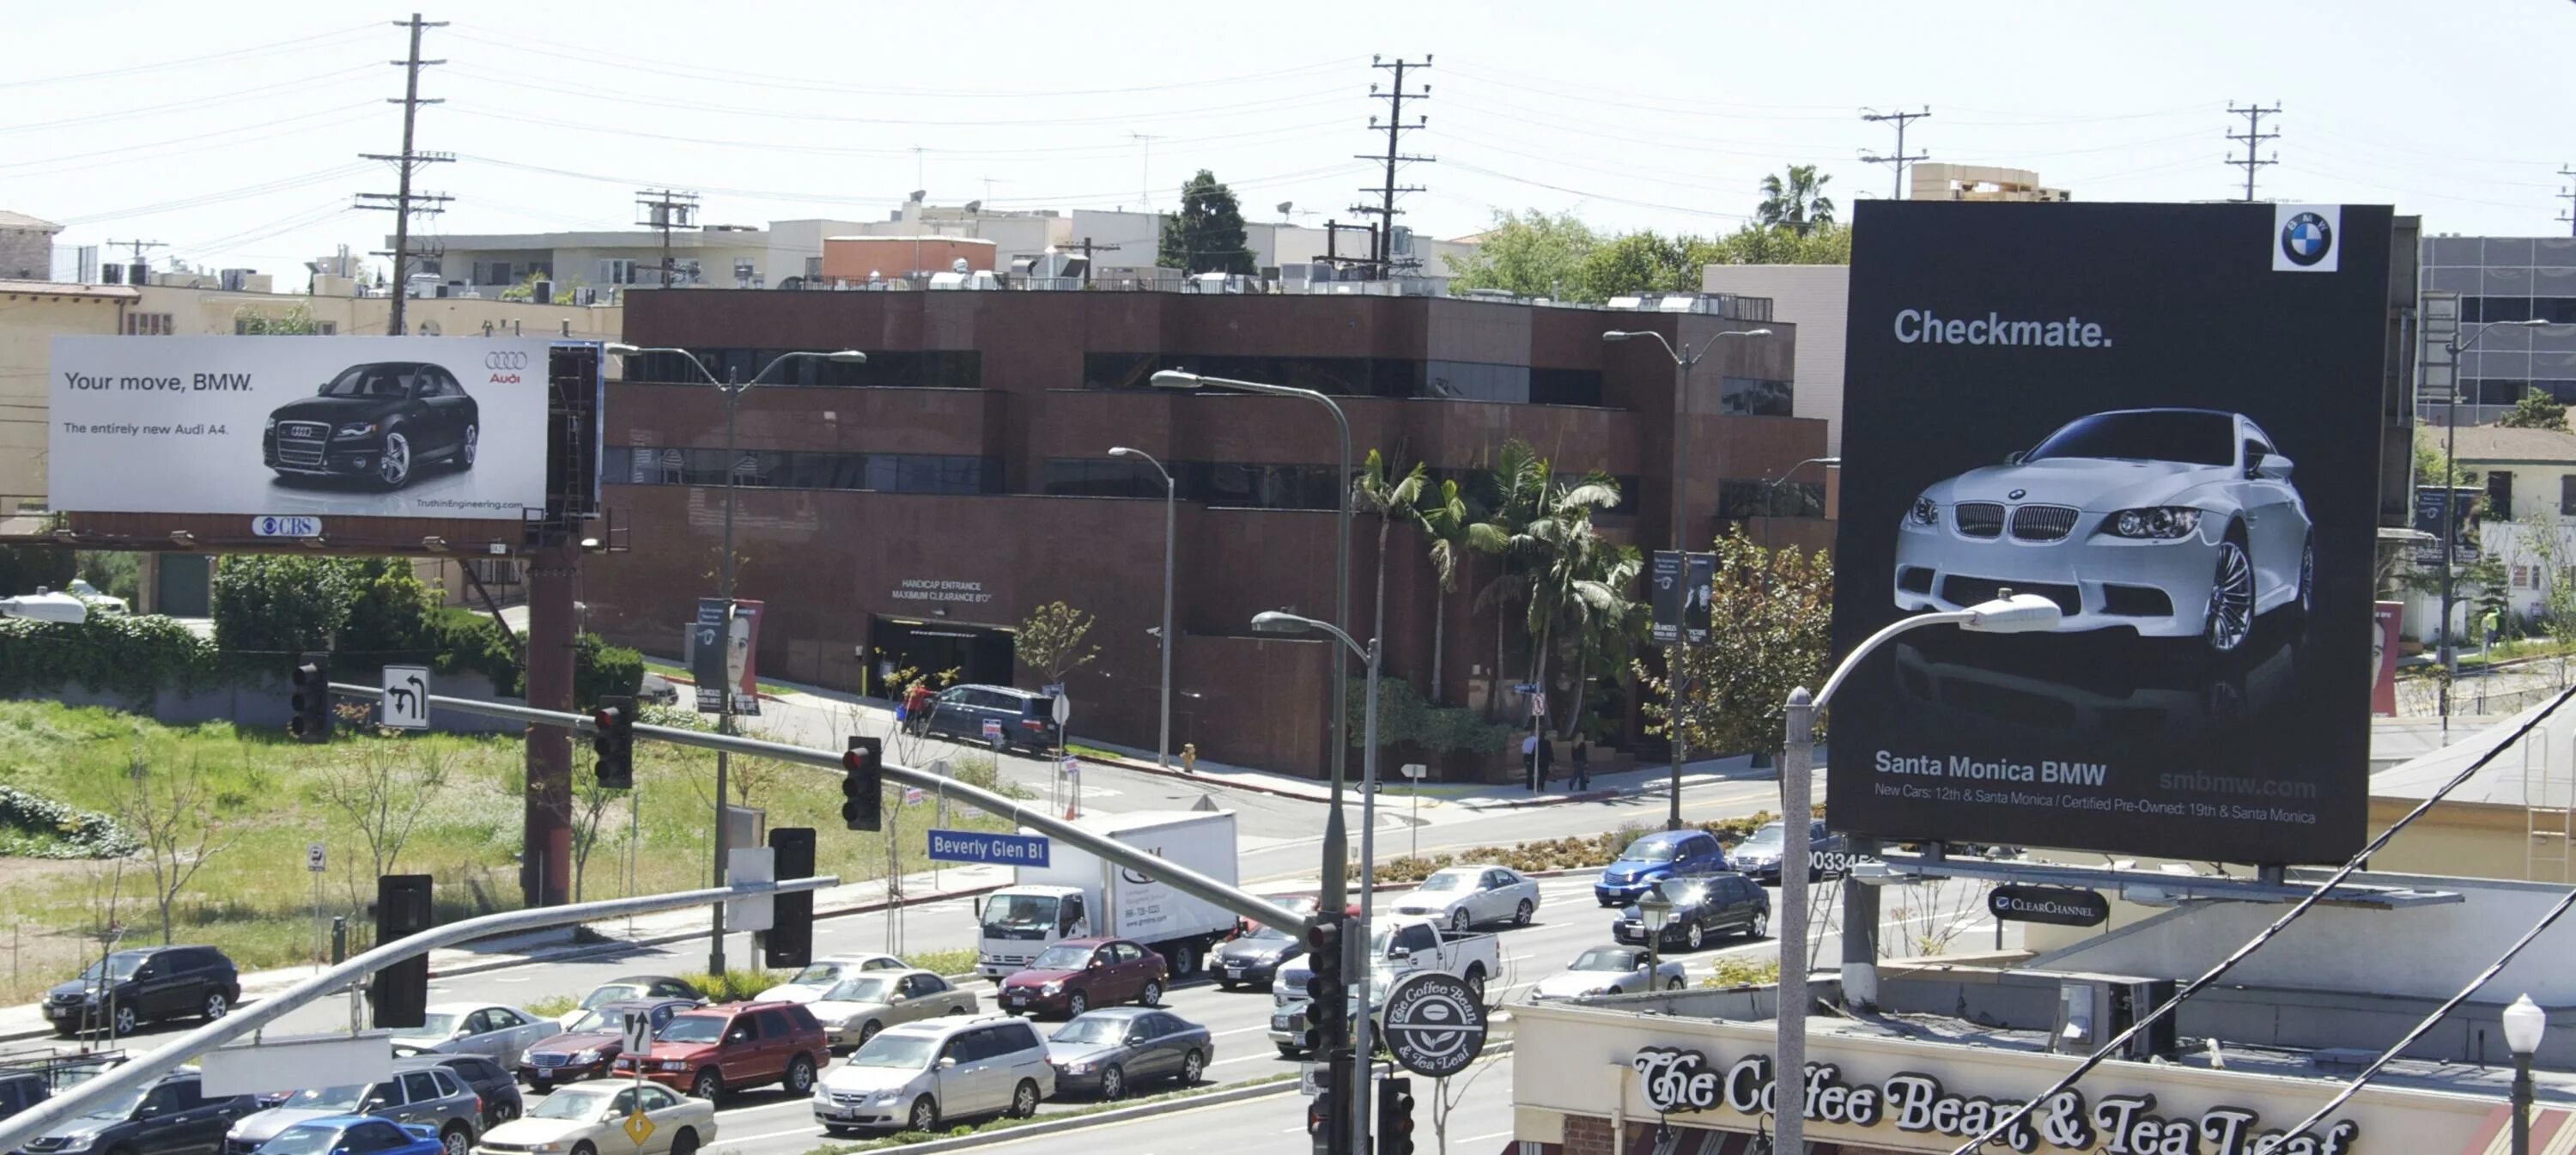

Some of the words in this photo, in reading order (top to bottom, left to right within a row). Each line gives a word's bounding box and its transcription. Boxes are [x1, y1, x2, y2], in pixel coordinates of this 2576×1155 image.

[2287, 214, 2329, 232] BMW
[1894, 308, 2112, 348] Checkmate.
[64, 372, 113, 391] Your
[120, 375, 186, 393] move,
[193, 373, 253, 392] BMW.
[489, 373, 520, 384] Audi
[64, 422, 87, 434] The
[91, 423, 139, 436] entirely
[143, 426, 171, 435] new
[175, 423, 204, 435] Audi
[208, 425, 228, 435] A4.
[279, 518, 312, 535] CBS
[892, 590, 928, 600] MAXIMUM
[929, 592, 975, 602] CLEARANCE
[902, 579, 939, 589] HANDICAP
[941, 581, 981, 591] ENTRANCE
[1875, 750, 1942, 776] Santa
[1948, 755, 2035, 782] Monica
[2041, 761, 2107, 787] BMW
[2159, 770, 2317, 799] smbmw.com
[1874, 782, 1900, 796] New
[1903, 783, 1931, 799] Cars:
[1935, 787, 1961, 801] 12th
[1963, 788, 1973, 802] &
[1975, 789, 2008, 804] Santa
[2011, 791, 2053, 806] Monica
[2062, 793, 2111, 811] Certified
[2113, 799, 2185, 815] Pre-Owned:
[2190, 802, 2216, 817] 19th
[2219, 805, 2229, 818] &
[2232, 805, 2268, 821] Santa
[2269, 808, 2316, 824] Monica
[934, 836, 987, 860] Beverly
[992, 840, 1024, 858] Glen
[1028, 843, 1043, 859] Bl
[1389, 1000, 1409, 1023] The
[1405, 981, 1449, 1002] Coffee
[1449, 985, 1477, 1024] Bean
[1412, 1053, 1435, 1070] Tea
[1437, 1044, 1470, 1070] Leaf
[1632, 1050, 1718, 1111] The
[1725, 1059, 1879, 1125] Cofee
[1883, 1075, 2030, 1152] Bean
[2042, 1091, 2087, 1148] &
[2093, 1098, 2193, 1155] Tea
